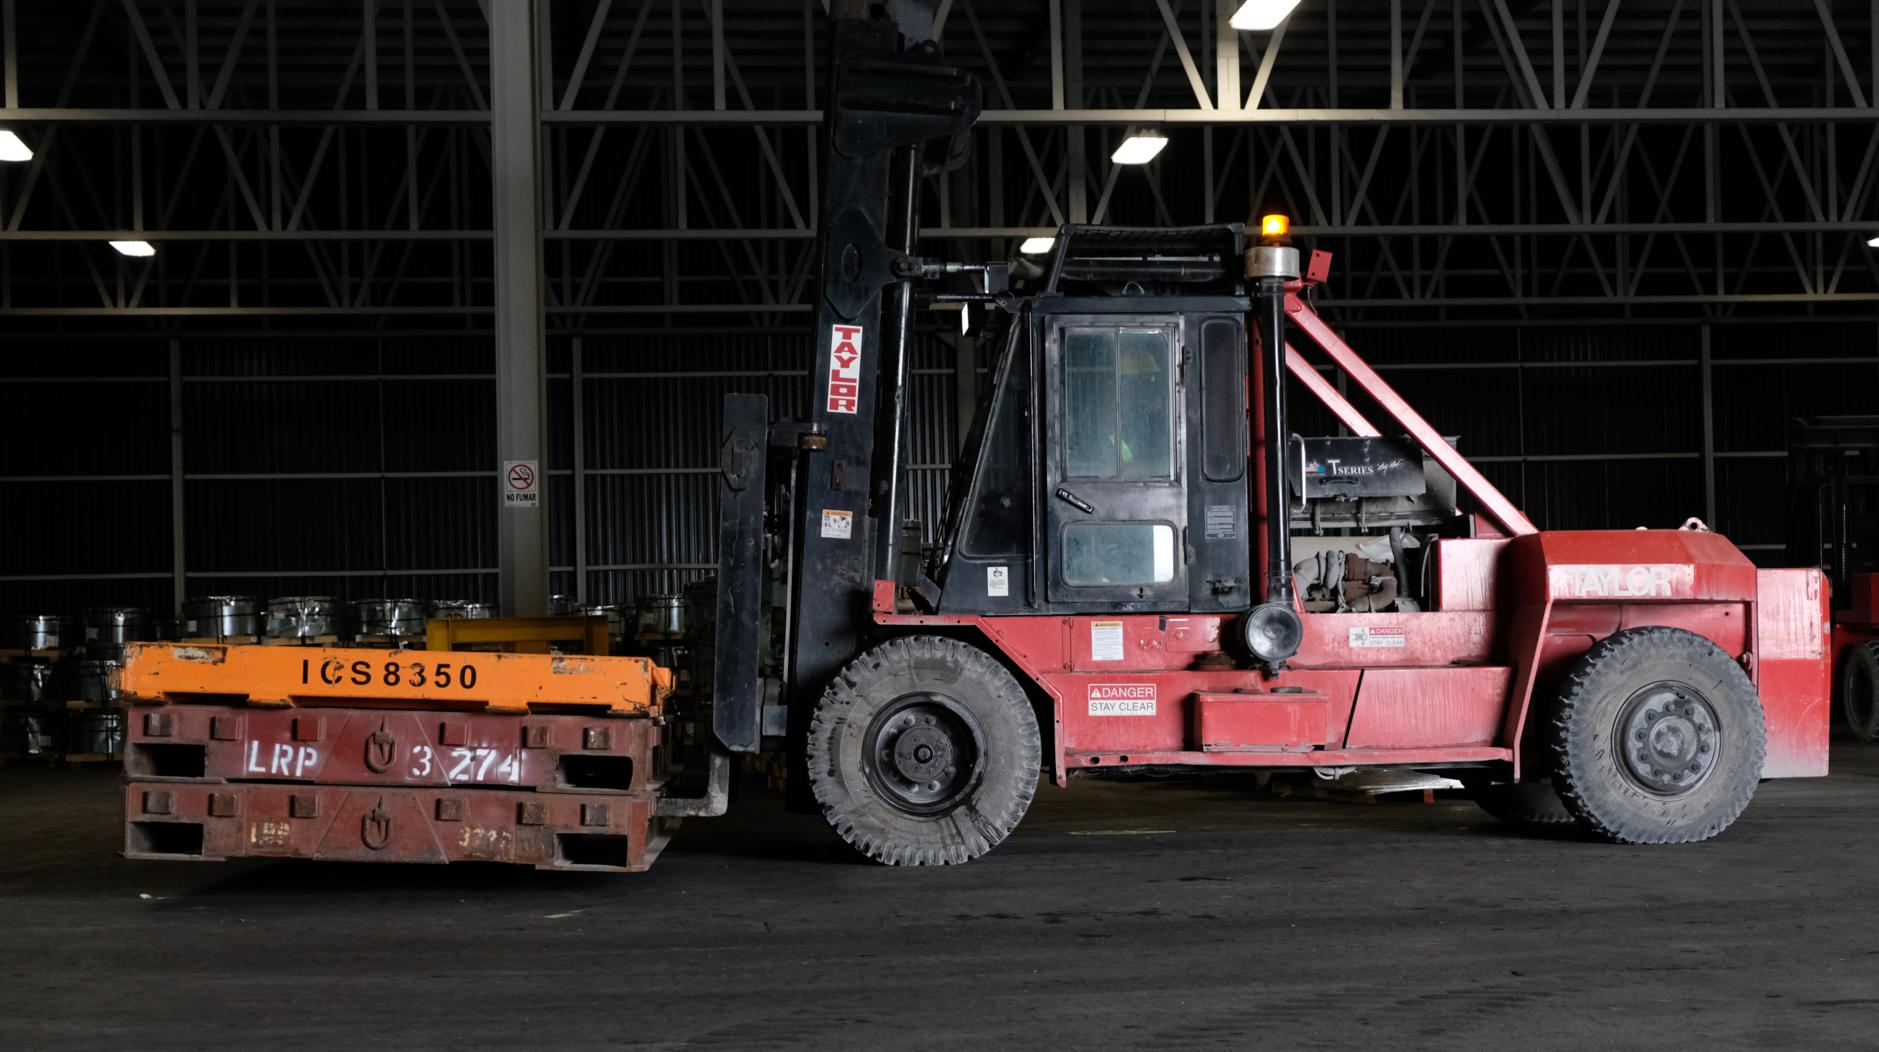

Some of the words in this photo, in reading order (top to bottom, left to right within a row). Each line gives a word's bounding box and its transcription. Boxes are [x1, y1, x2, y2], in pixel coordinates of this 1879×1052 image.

[829, 326, 861, 412] TAYLOR
[506, 493, 515, 502] NO
[515, 493, 537, 502] FUMAR
[1567, 566, 1673, 597] TAYLOR
[1102, 687, 1154, 698] DANGER
[1091, 702, 1116, 711] STAY
[1119, 702, 1154, 711] CLEAR
[248, 740, 318, 777] LRP
